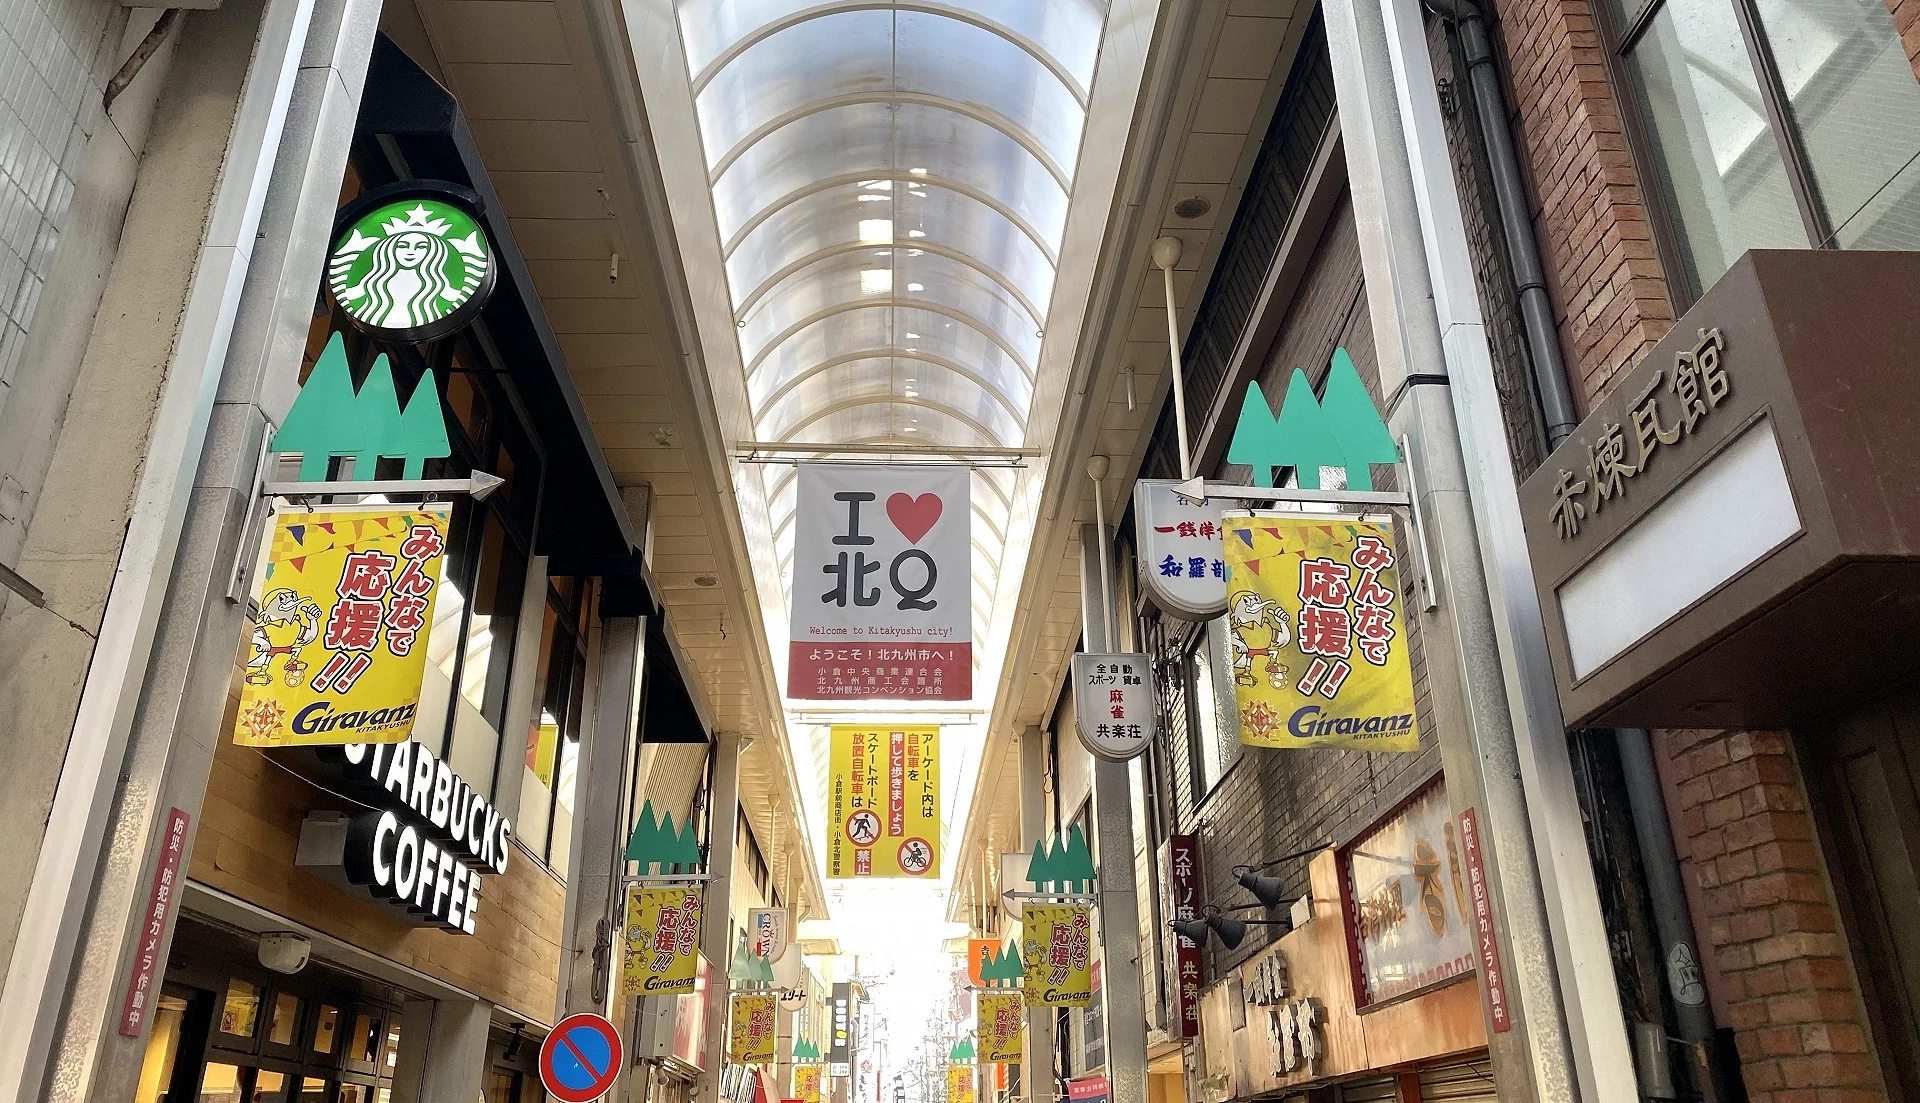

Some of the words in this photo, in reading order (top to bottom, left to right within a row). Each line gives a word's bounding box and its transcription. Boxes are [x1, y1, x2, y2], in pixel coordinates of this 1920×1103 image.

[832, 491, 876, 546] I
[384, 525, 444, 657] みんなで
[820, 548, 938, 612] 北Q
[1352, 535, 1395, 666] みんなで
[310, 550, 397, 695] 応援!!
[809, 626, 848, 635] Welcome
[853, 627, 864, 635] to
[868, 626, 922, 637] Kitakyushu
[927, 626, 954, 638] city!
[1296, 557, 1352, 700] 応援!!
[809, 648, 954, 661] ようこそ！北九州市へ！
[817, 667, 942, 676] 小倉中央商業連合会
[1096, 663, 1133, 675] 全自動
[816, 685, 942, 695] 北九州観光コンベンション協会
[817, 676, 942, 686] 北九州商工会議所
[1088, 675, 1117, 686] スポーツ
[1109, 689, 1125, 719] 麻雀
[291, 701, 417, 735] Giravanz
[355, 719, 411, 733] KITAKYUSHU
[1096, 723, 1142, 739] 共楽荘
[1287, 705, 1414, 738] Giravanz
[1353, 728, 1411, 741] KITAKYUSHU
[851, 733, 865, 808] 放置自転車は
[866, 733, 879, 809] スケートボード
[907, 733, 920, 781] 自転車を
[921, 733, 934, 818] アーケード内は
[890, 733, 904, 836] 押して歩きましょう
[373, 811, 482, 935] COFFEE
[856, 849, 871, 876] 禁止
[129, 816, 185, 1027] 防災・防犯用カメラ作動中
[650, 906, 681, 973] 応援!!
[678, 894, 701, 956] みんなで
[1071, 913, 1090, 971] みんなで
[1461, 817, 1504, 1023] 防災・防犯用カメラ作動中
[1047, 923, 1071, 986] 応援!!
[763, 1001, 776, 1040] みんなで
[1008, 1000, 1021, 1039] みんなで
